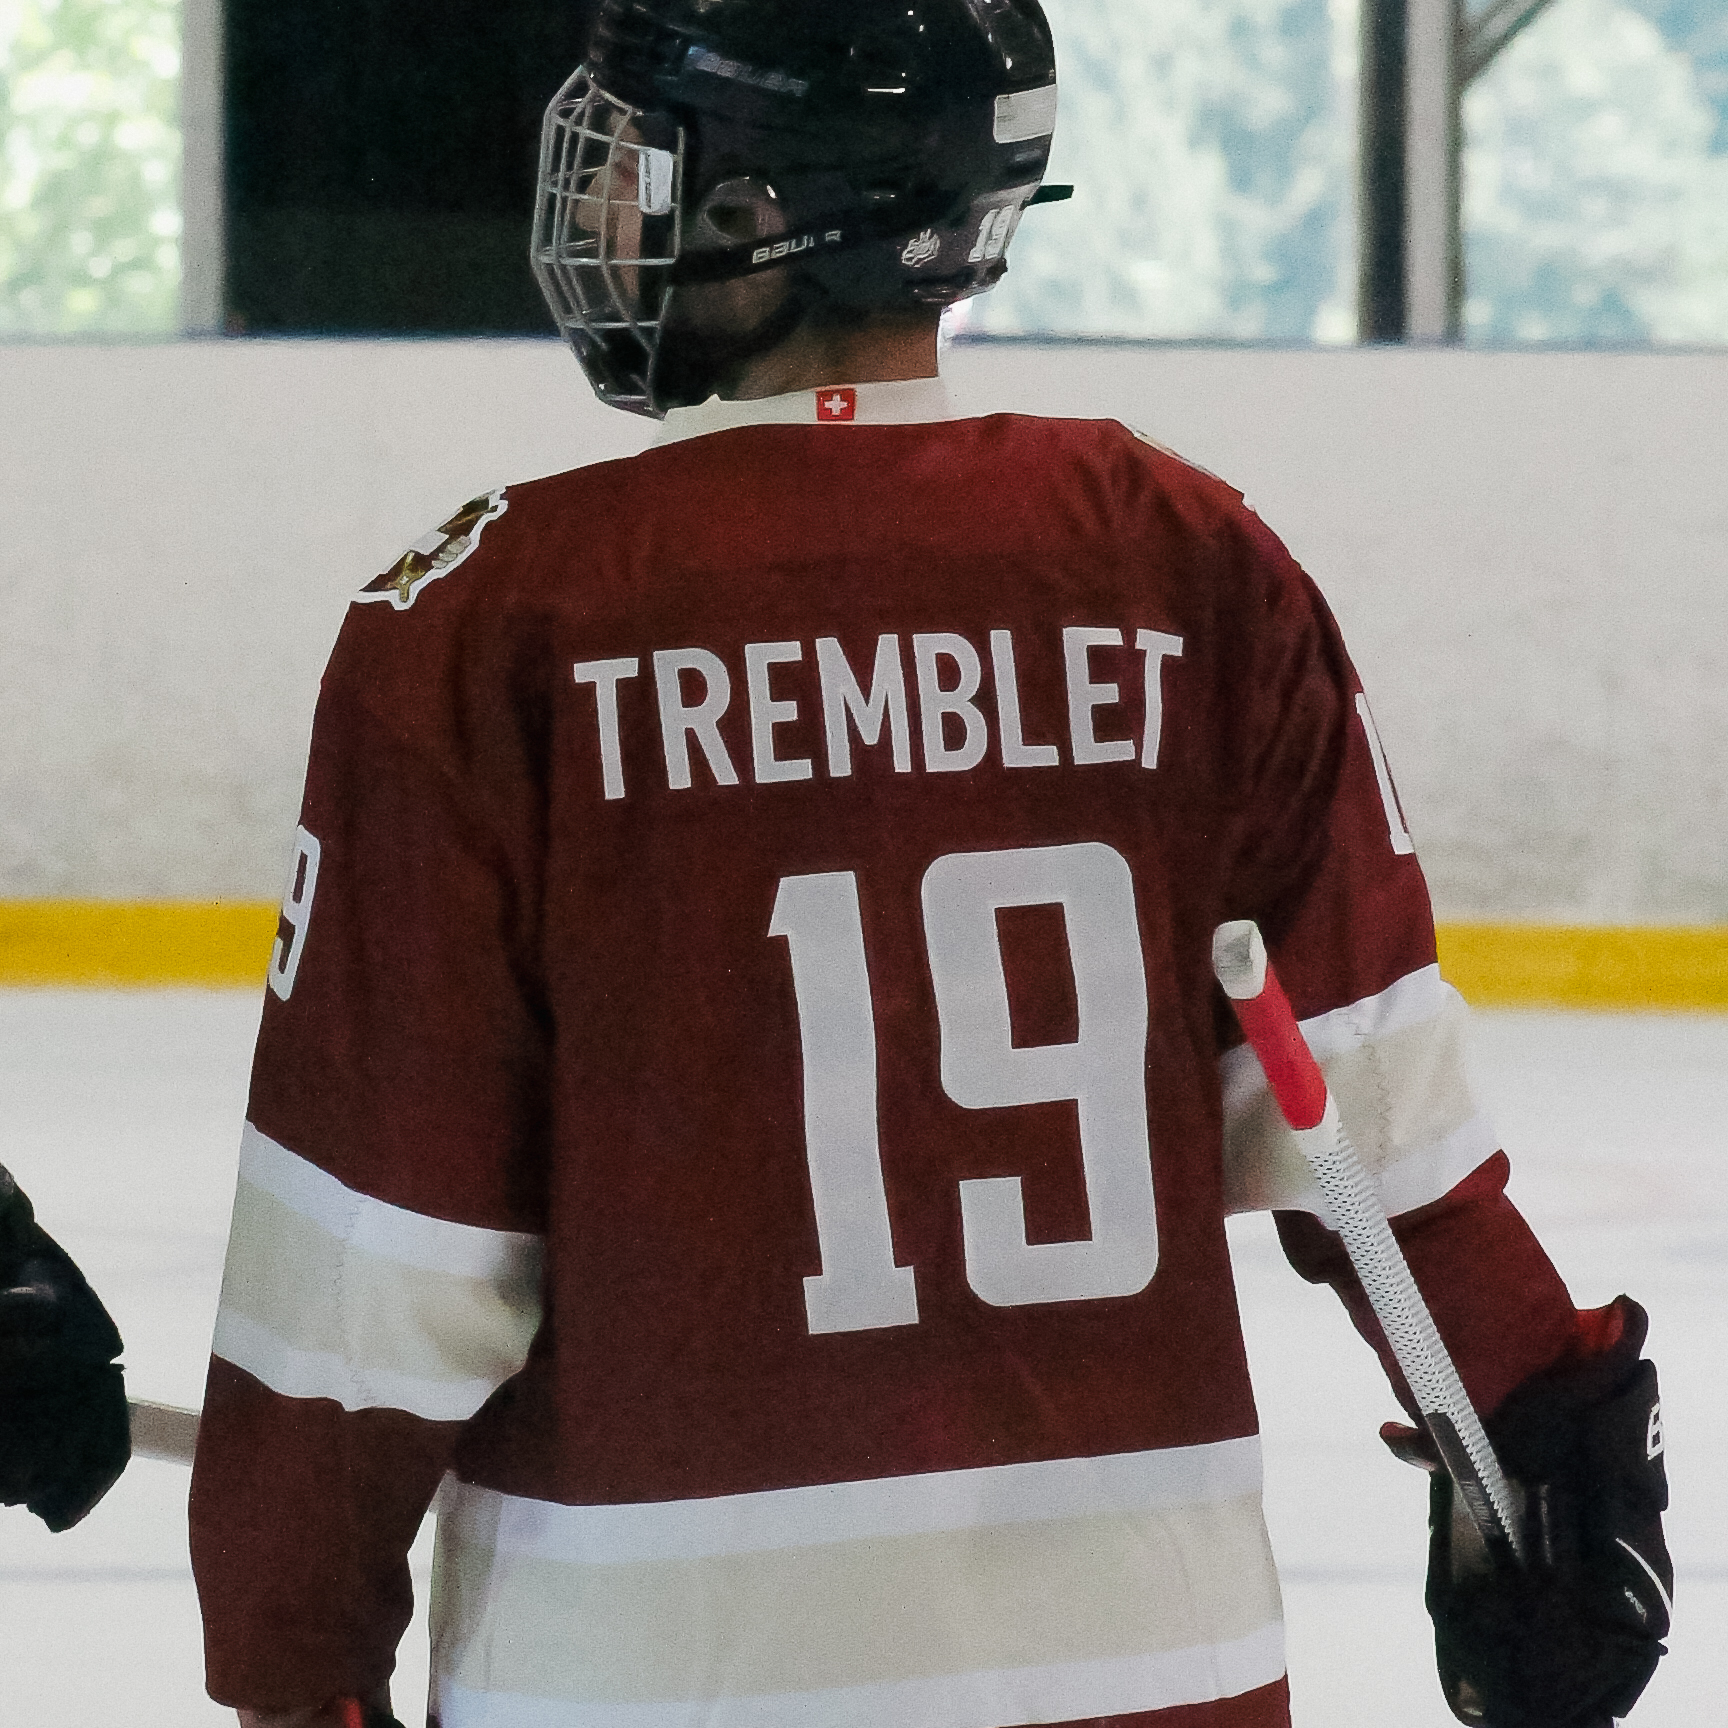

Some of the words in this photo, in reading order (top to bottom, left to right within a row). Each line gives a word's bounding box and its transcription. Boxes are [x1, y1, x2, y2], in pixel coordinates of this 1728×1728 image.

[752, 229, 842, 264] BAUR
[573, 626, 1184, 800] TREMBLET
[767, 841, 1159, 1335] 19
